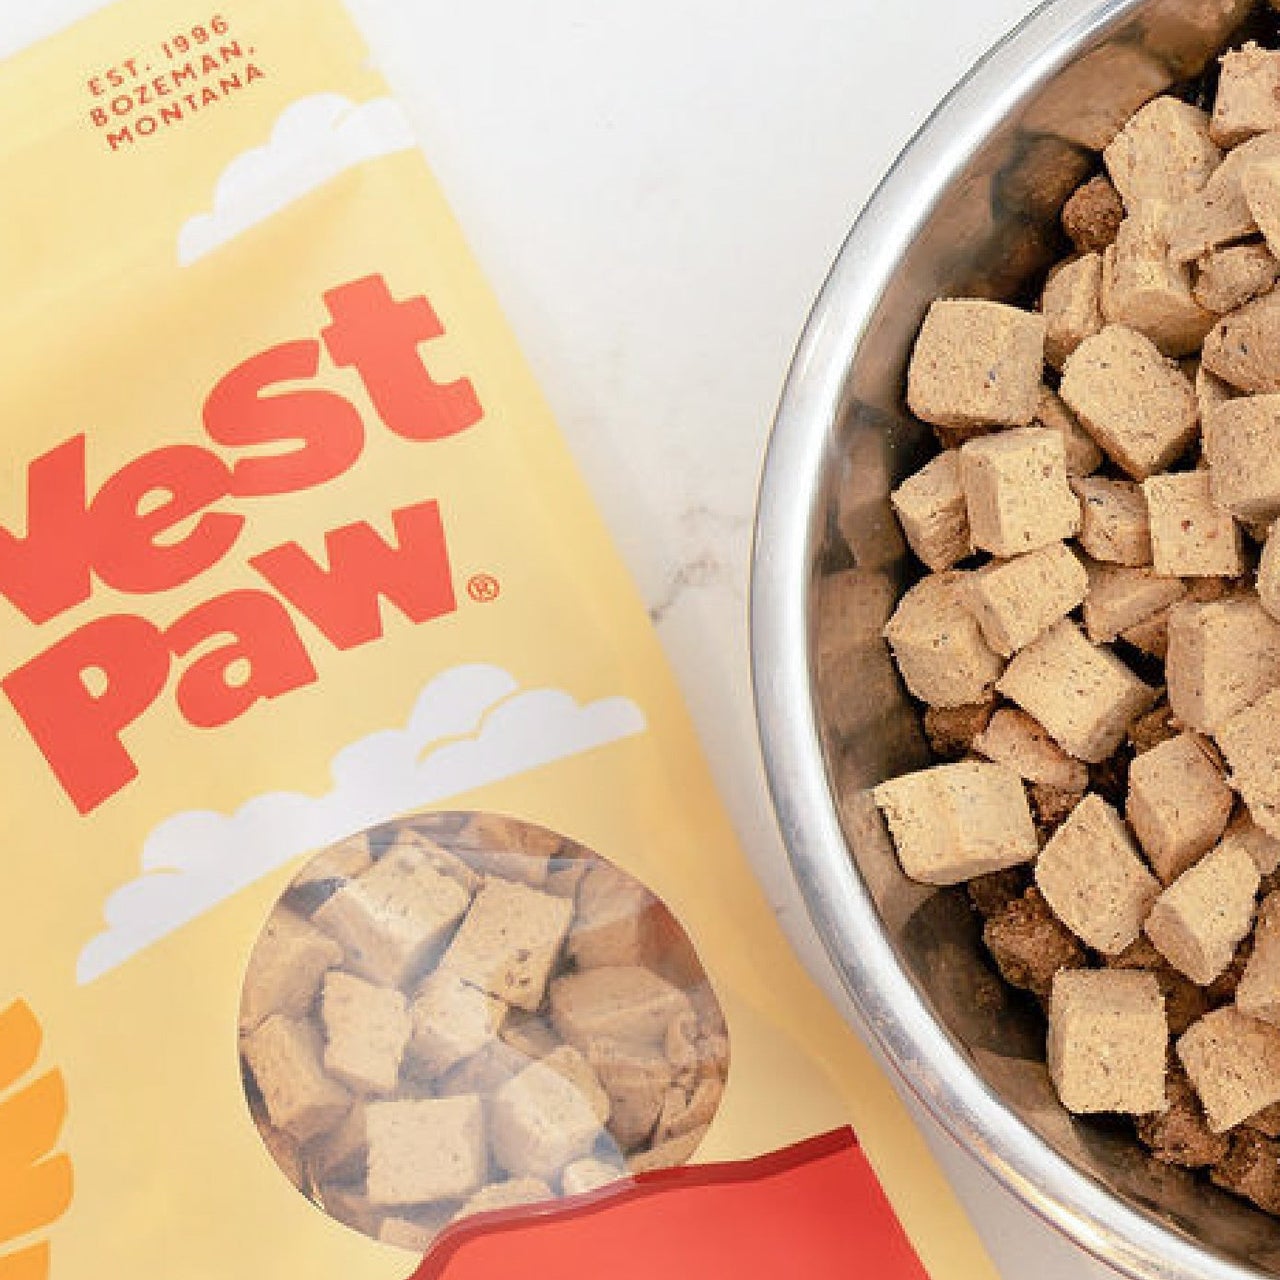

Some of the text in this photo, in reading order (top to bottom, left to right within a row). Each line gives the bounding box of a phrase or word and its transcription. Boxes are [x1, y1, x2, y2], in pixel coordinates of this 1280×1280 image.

[88, 14, 229, 98] EST. 1996
[106, 63, 266, 152] MONTANA
